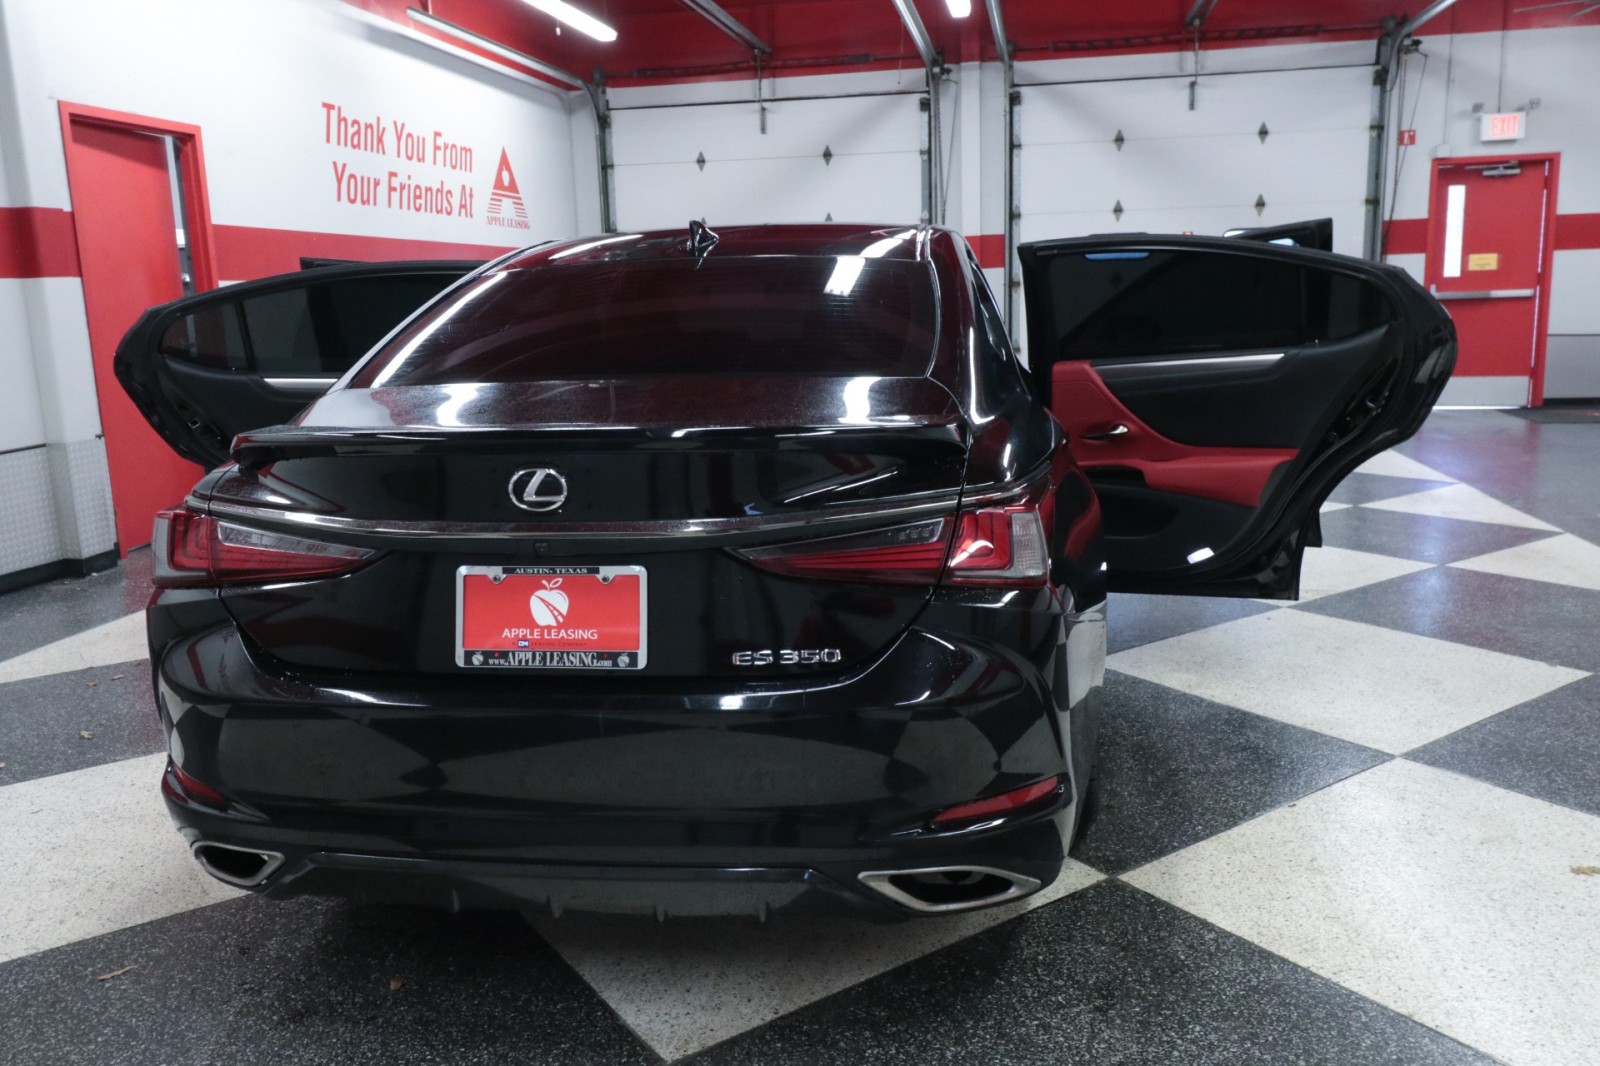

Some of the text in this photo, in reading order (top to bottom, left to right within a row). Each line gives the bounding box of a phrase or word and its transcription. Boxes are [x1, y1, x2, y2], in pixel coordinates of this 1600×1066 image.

[1491, 114, 1520, 137] EXIT
[322, 102, 473, 173] Thank You From
[332, 161, 474, 219] Your Friends At
[486, 215, 506, 227] APPLE
[502, 628, 598, 640] APPLE LEASING
[732, 648, 842, 665] ES 350
